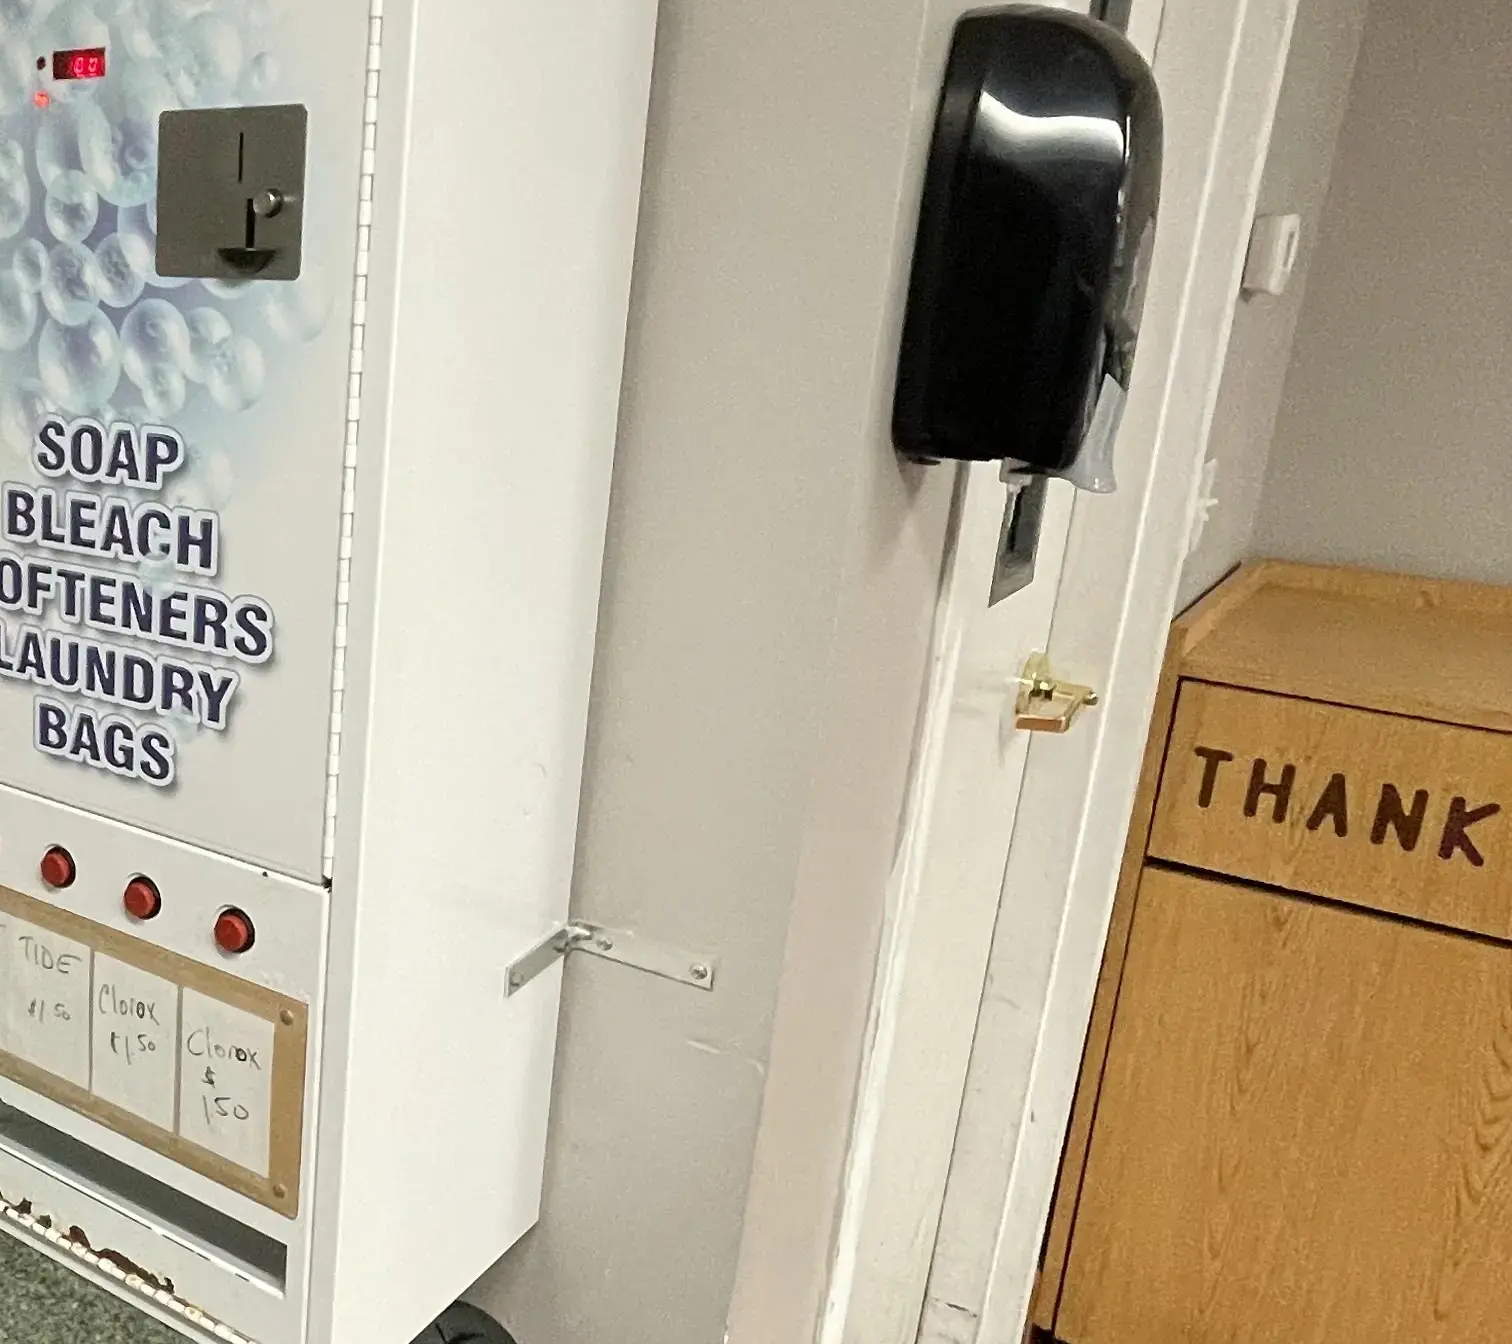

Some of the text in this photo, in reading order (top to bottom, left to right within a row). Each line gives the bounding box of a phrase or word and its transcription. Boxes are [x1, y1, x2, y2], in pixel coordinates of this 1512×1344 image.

[35, 417, 182, 486] SOAP
[5, 486, 216, 572] BLEACH
[37, 700, 173, 783] BAGS
[1193, 745, 1501, 868] THANK
[18, 935, 83, 975] TIDE
[98, 983, 160, 1026] Clorox
[187, 1026, 263, 1071] Clorox
